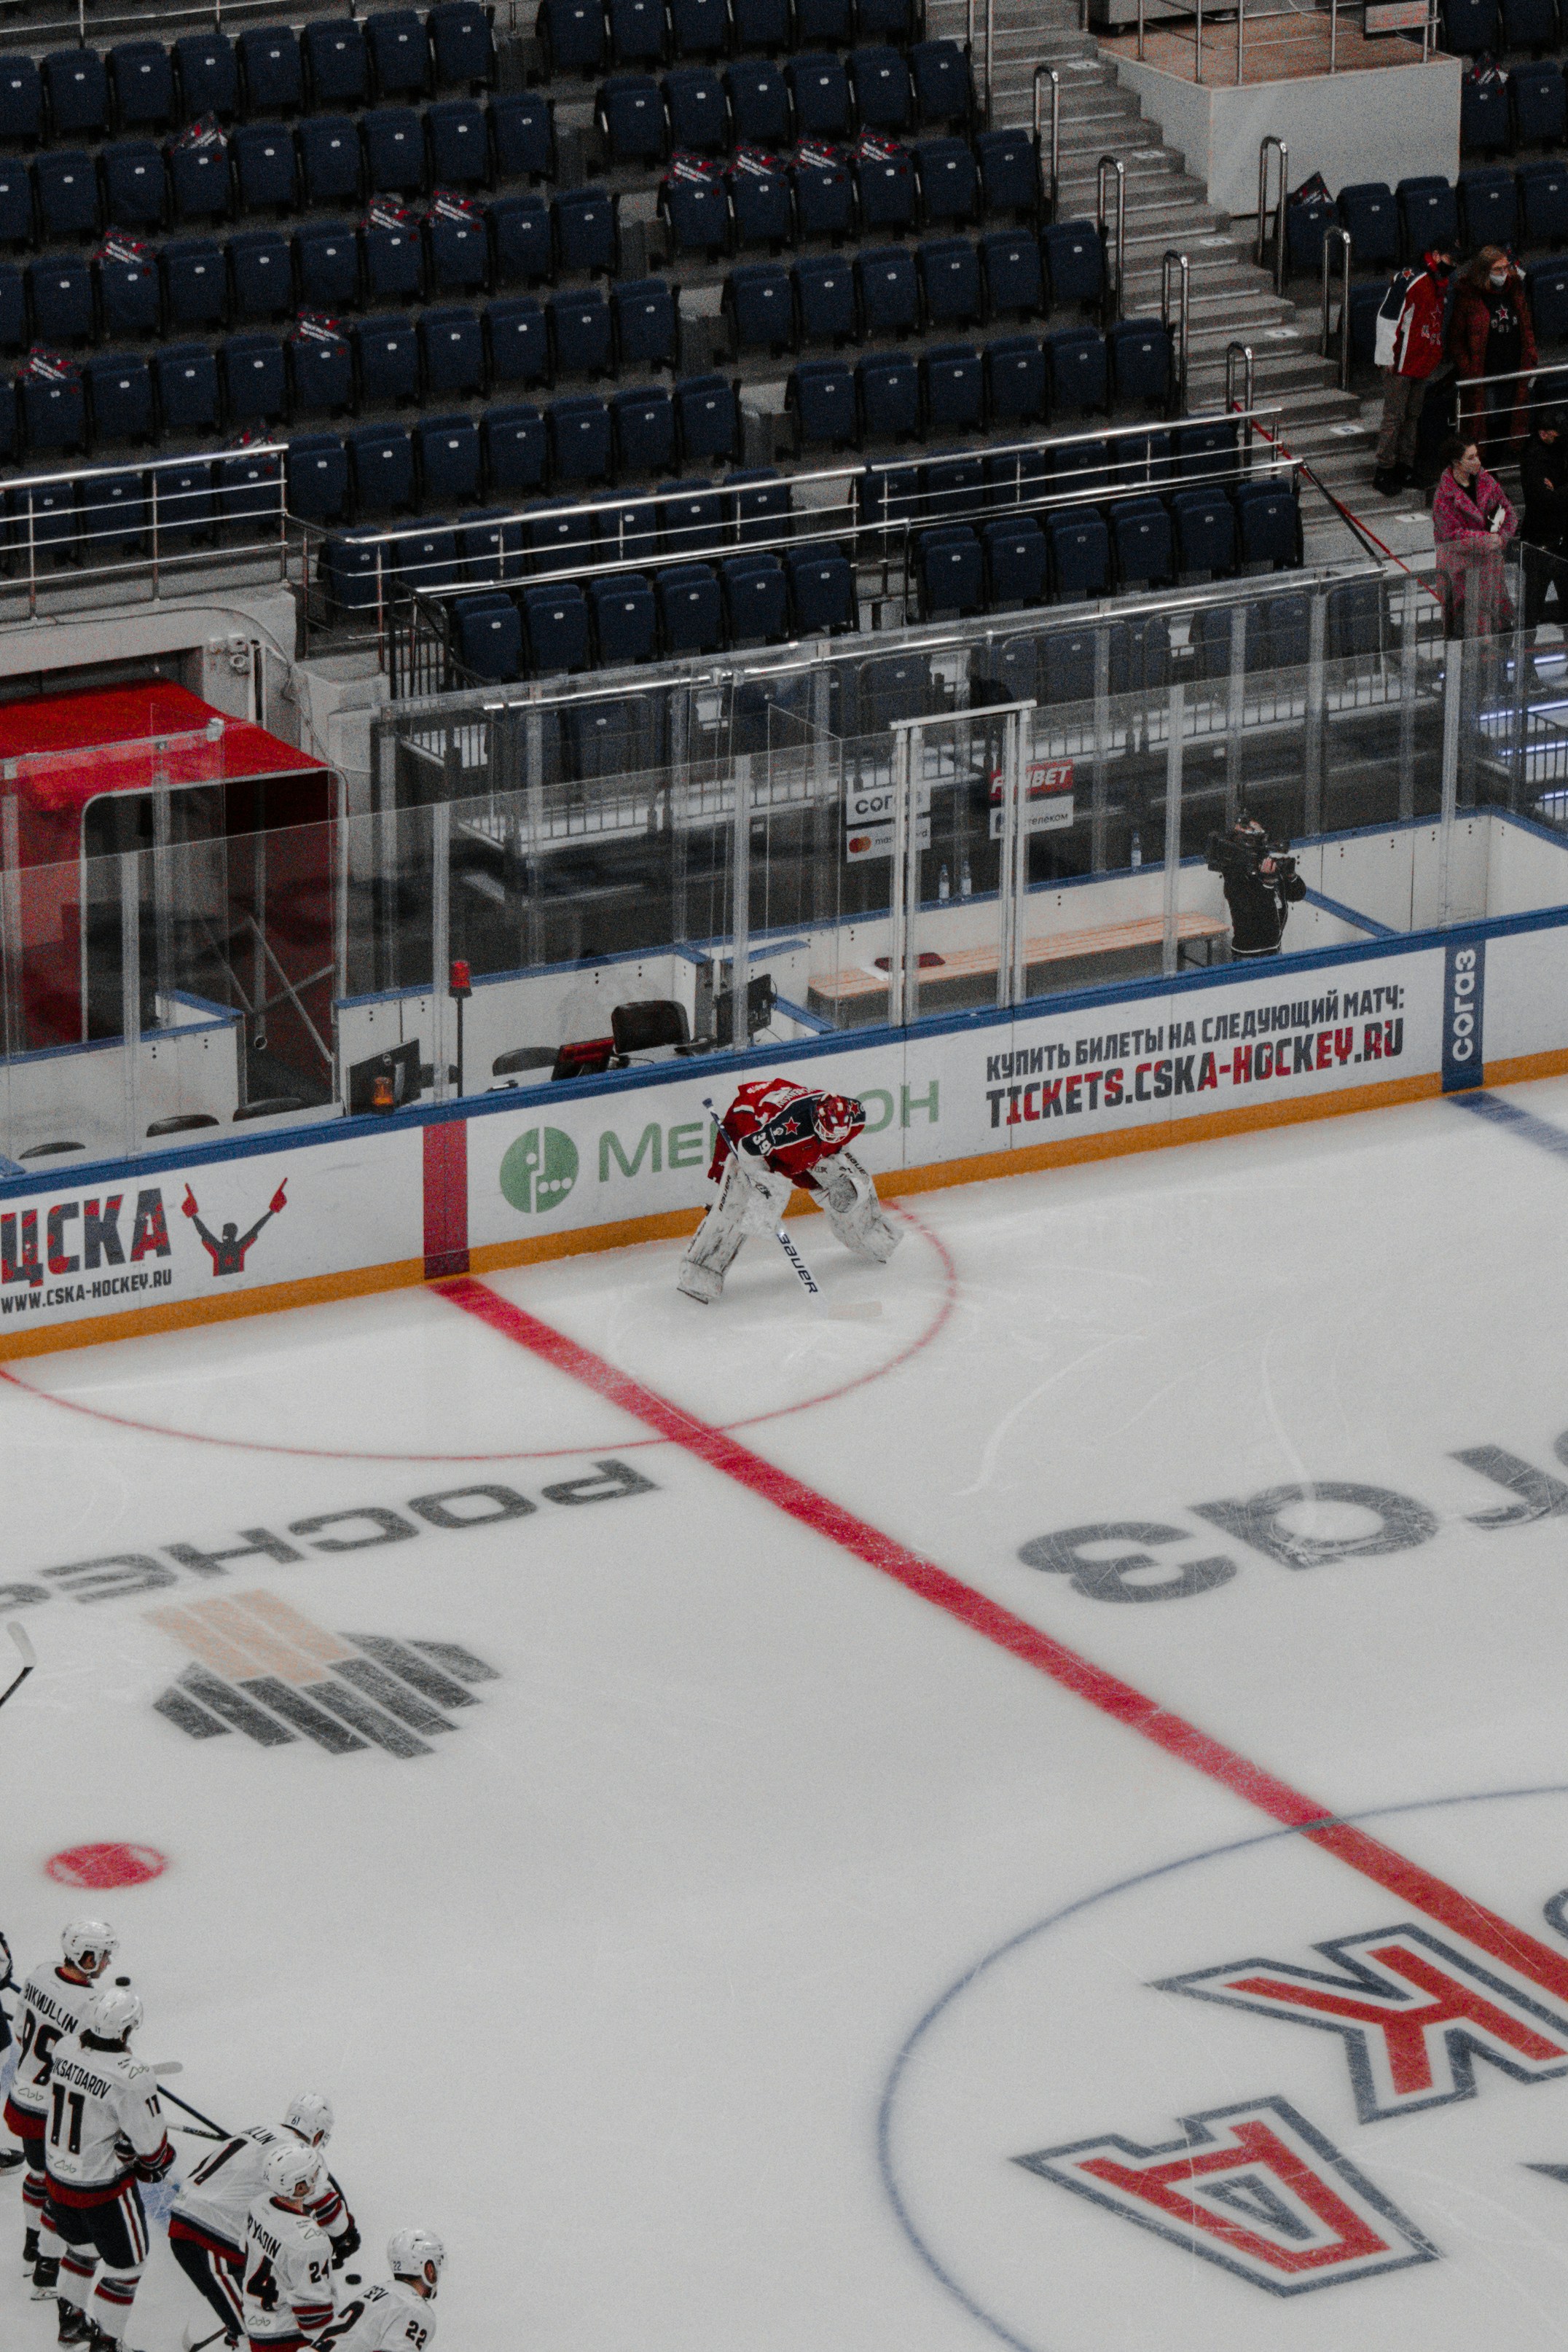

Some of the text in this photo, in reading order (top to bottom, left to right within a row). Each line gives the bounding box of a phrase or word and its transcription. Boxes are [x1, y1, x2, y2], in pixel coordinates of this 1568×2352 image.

[987, 984, 1405, 1082] КУПИТЬ БИЛЕТЫ НА СЛЕДУЮЩИЙ МАТЧ:
[986, 1018, 1404, 1128] TICKETS.CSKA-HOCKEY.RU
[752, 1132, 772, 1156] 39
[1, 1188, 172, 1288] ЦСКА
[1, 1269, 172, 1314] WWW.CSKA-HOCKEY.RU
[50, 2082, 86, 2155] 11
[144, 2094, 161, 2117] 11
[405, 2320, 428, 2351] 22
